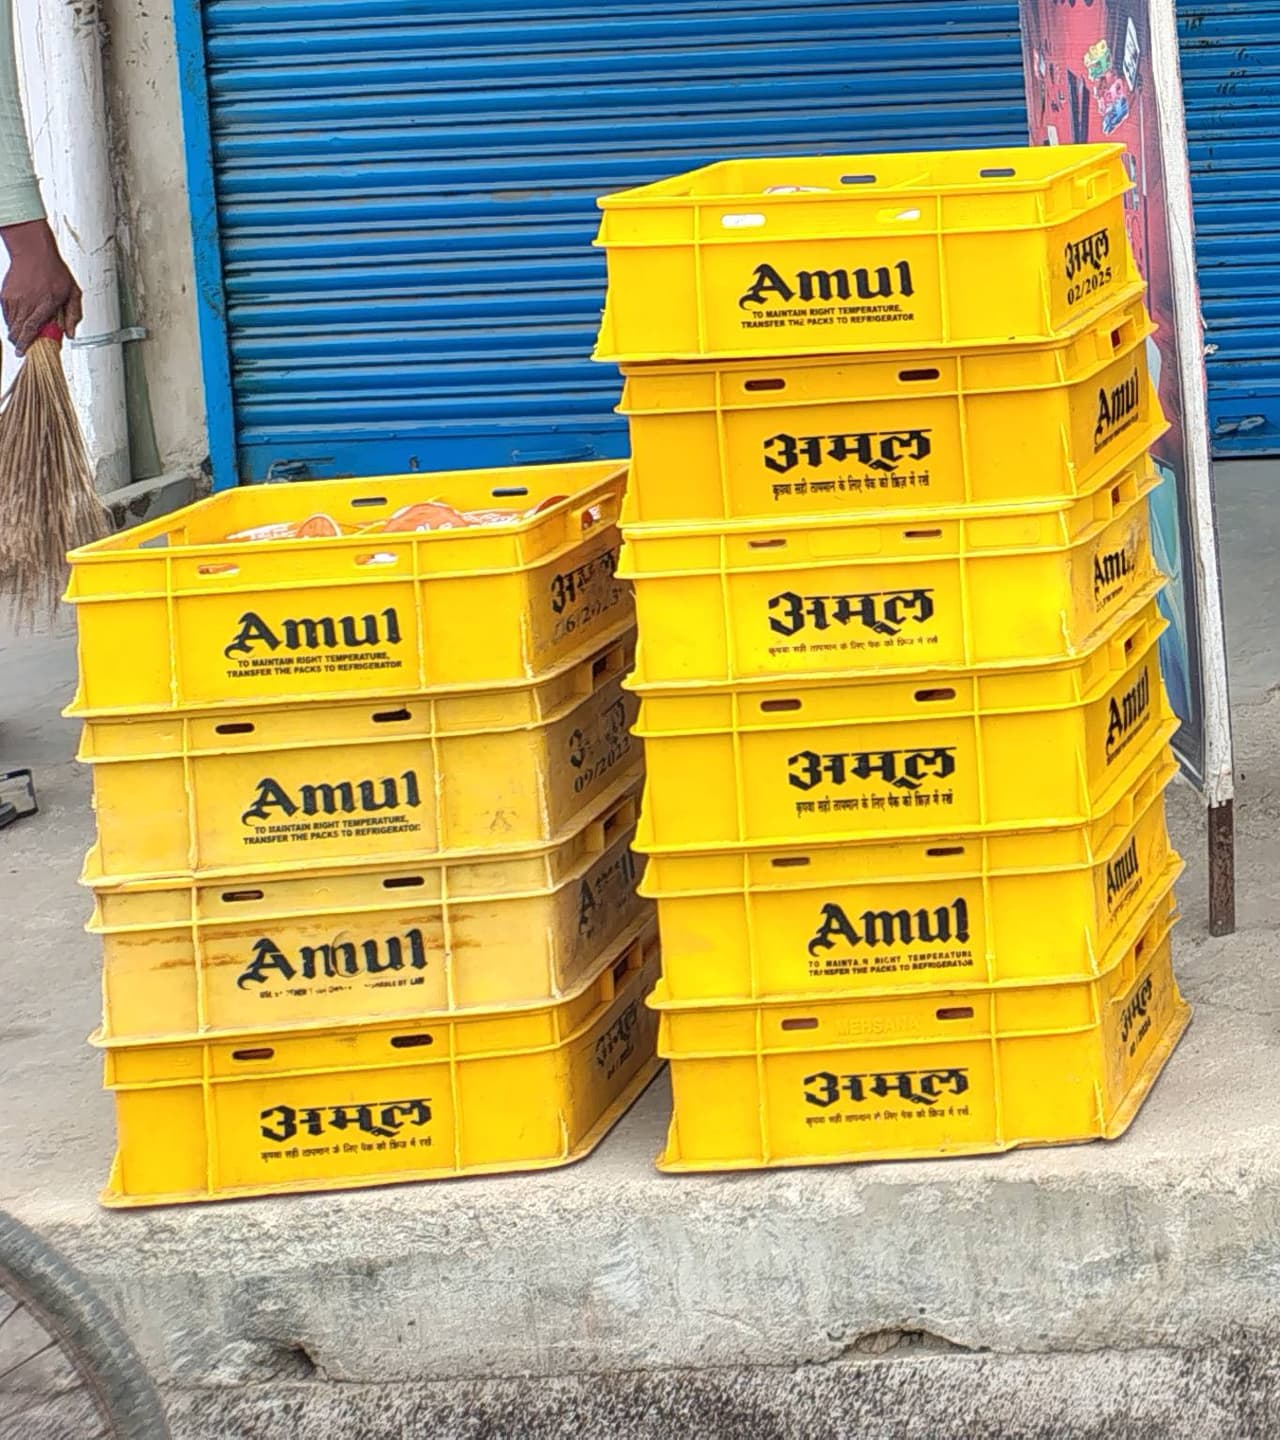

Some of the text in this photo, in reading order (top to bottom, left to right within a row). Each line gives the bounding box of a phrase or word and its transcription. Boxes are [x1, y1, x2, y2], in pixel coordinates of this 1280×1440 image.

[739, 260, 915, 311] Amul
[1067, 266, 1112, 306] 02/2025
[741, 321, 785, 329] TRANSFER
[850, 313, 914, 324] REFRIGERATOR
[752, 311, 763, 319] TO
[766, 309, 807, 318] MAINTAIN
[809, 307, 835, 316] RIGHT
[763, 428, 933, 474] अमूल
[224, 607, 403, 659] Amul
[768, 588, 934, 637] अमूल
[787, 745, 957, 791] अमूल
[241, 769, 422, 827] Amul
[808, 897, 970, 957] Amul
[237, 928, 428, 990] Amul
[803, 1067, 969, 1108] अमूल
[260, 1098, 432, 1143] अमूल
